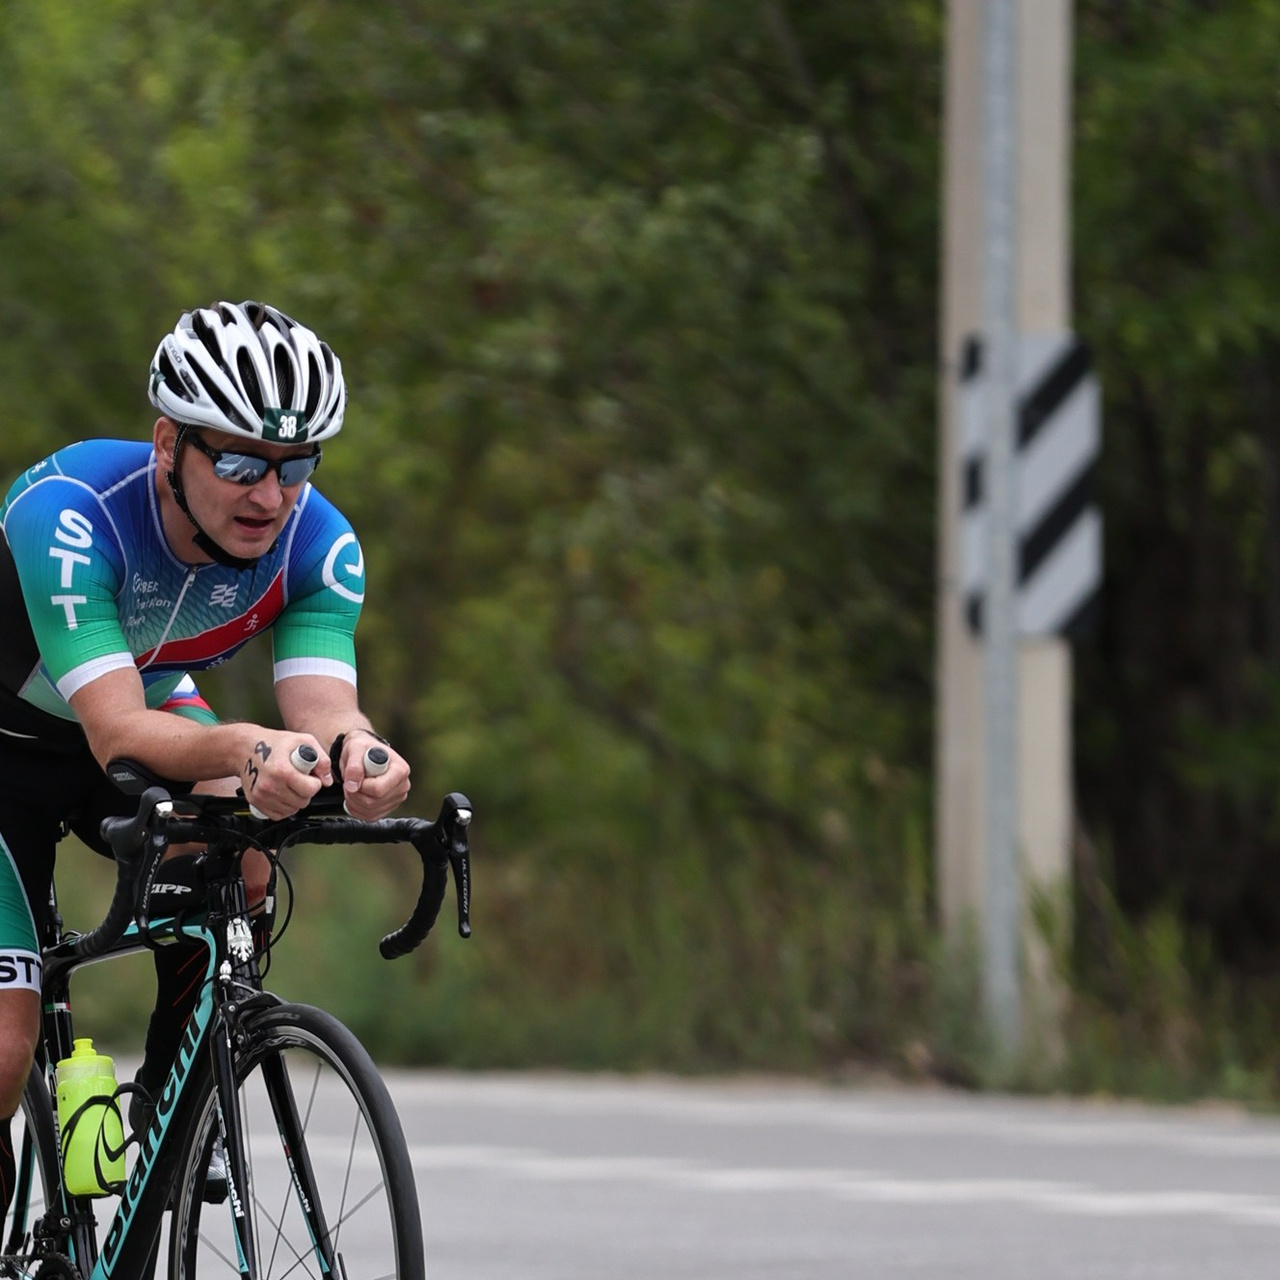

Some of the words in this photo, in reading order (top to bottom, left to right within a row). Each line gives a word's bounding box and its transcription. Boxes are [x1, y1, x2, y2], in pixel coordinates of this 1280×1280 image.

[278, 415, 297, 438] 38
[48, 508, 93, 631] STT
[103, 1010, 201, 1270] Bianchi
[224, 1147, 245, 1218] Bianchi
